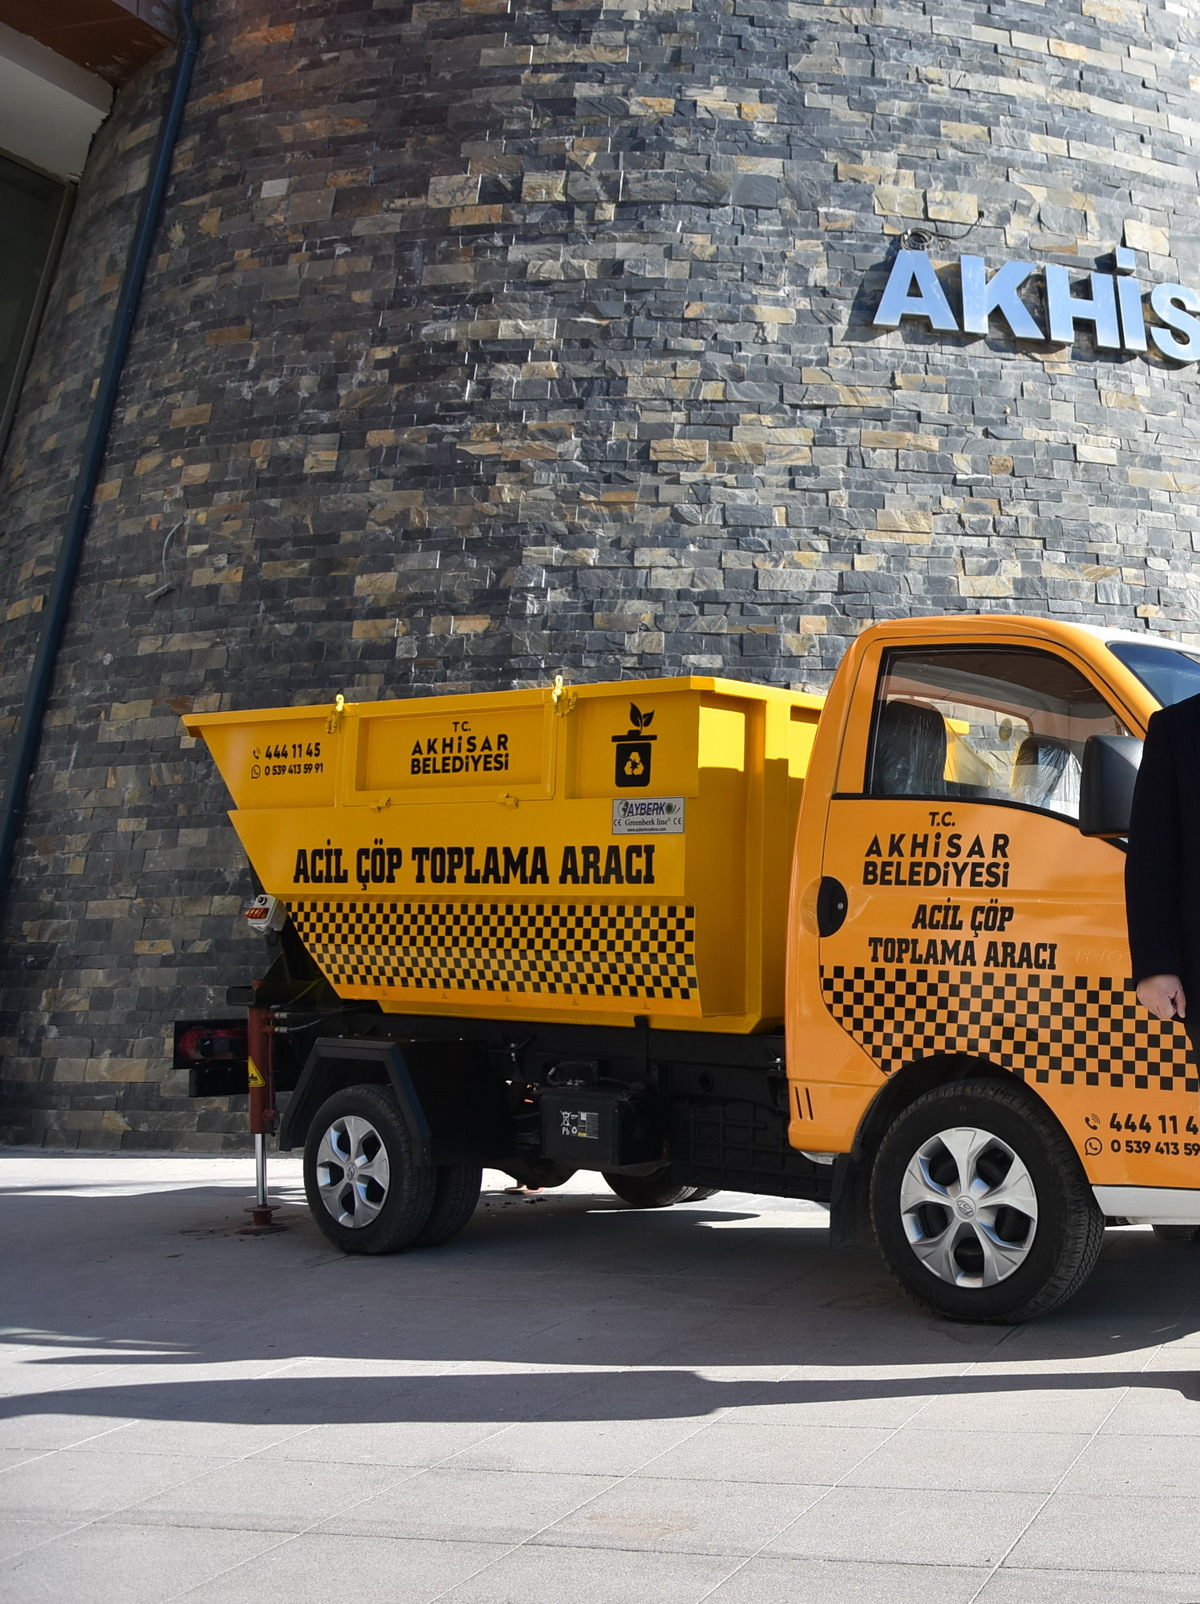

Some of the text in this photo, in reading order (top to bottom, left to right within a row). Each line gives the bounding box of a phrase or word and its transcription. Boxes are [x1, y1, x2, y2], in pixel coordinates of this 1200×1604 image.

[265, 742, 321, 759] 444 11 45
[264, 762, 323, 776] 0 539 413 59 91
[627, 802, 667, 816] AYBERK
[928, 811, 956, 827] T.C.
[293, 838, 655, 891] ACİL ÇÖP TOPLAMA ARACI
[911, 897, 1014, 938] ACİL ÇÖP
[868, 937, 1058, 970] TOPLAMA ARACI
[1109, 1112, 1152, 1133] 444
[1158, 1115, 1178, 1134] 11
[1110, 1139, 1121, 1153] 0
[1125, 1140, 1151, 1154] 539
[1155, 1142, 1180, 1155] 413
[1184, 1143, 1200, 1156] 59
